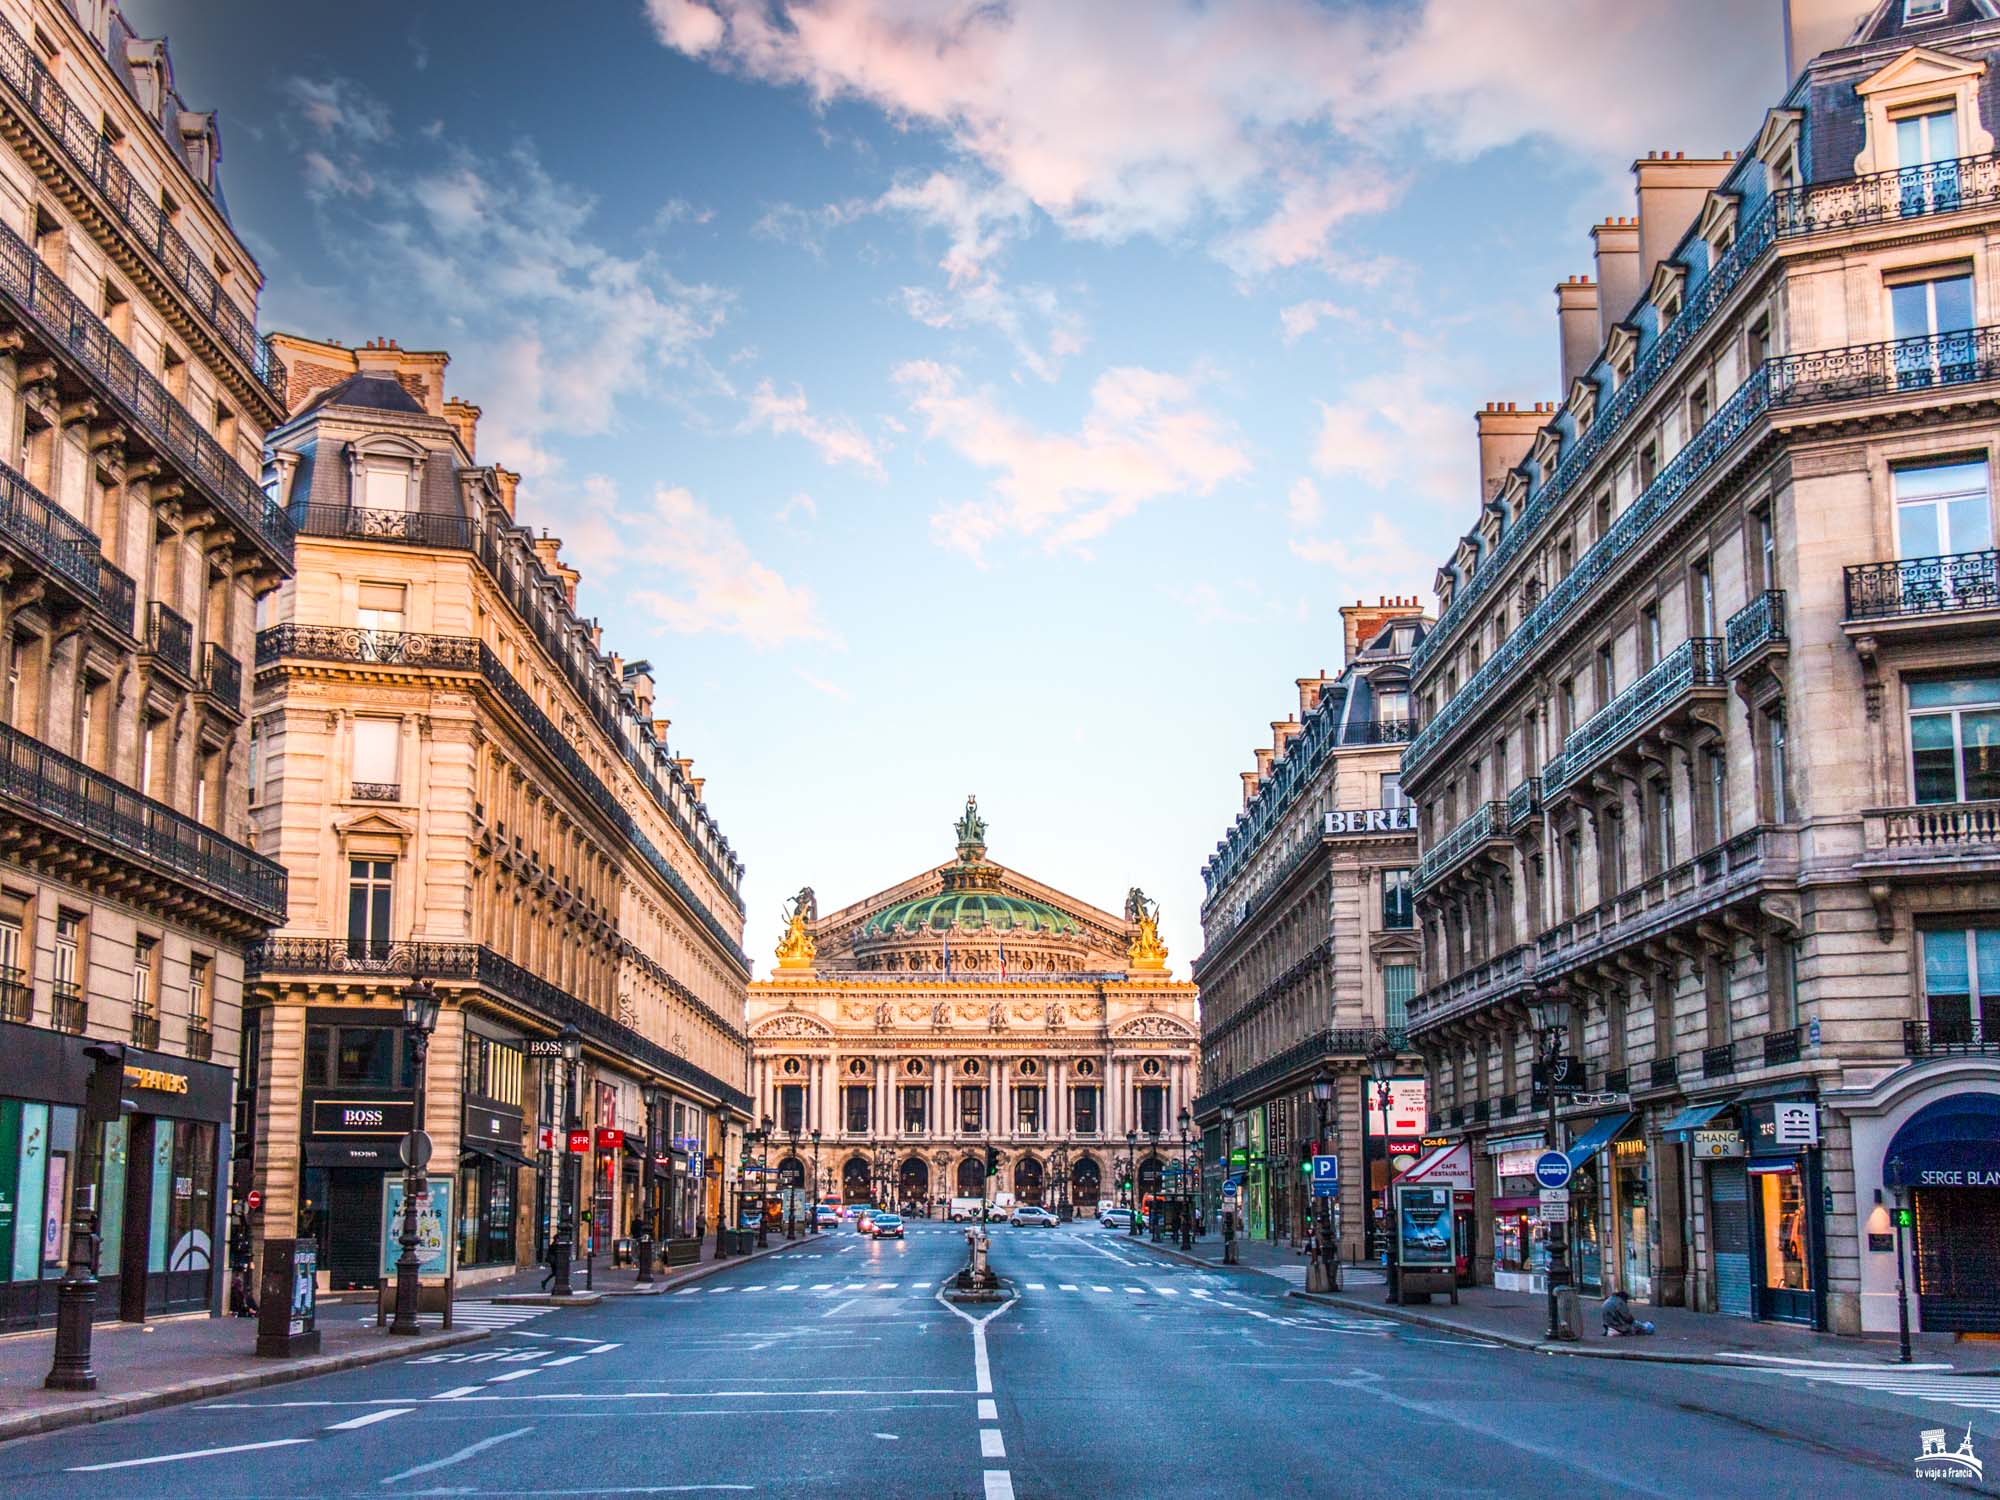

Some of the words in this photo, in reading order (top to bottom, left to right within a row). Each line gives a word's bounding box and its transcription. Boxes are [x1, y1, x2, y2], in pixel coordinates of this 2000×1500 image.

[344, 1110, 383, 1122] BOSS
[572, 1136, 589, 1145] SFR
[1423, 1137, 1448, 1147] Café
[1695, 1132, 1740, 1143] CHANG
[1320, 1160, 1331, 1176] P
[1921, 1170, 1963, 1185] SERGE
[404, 1351, 556, 1365] BUS
